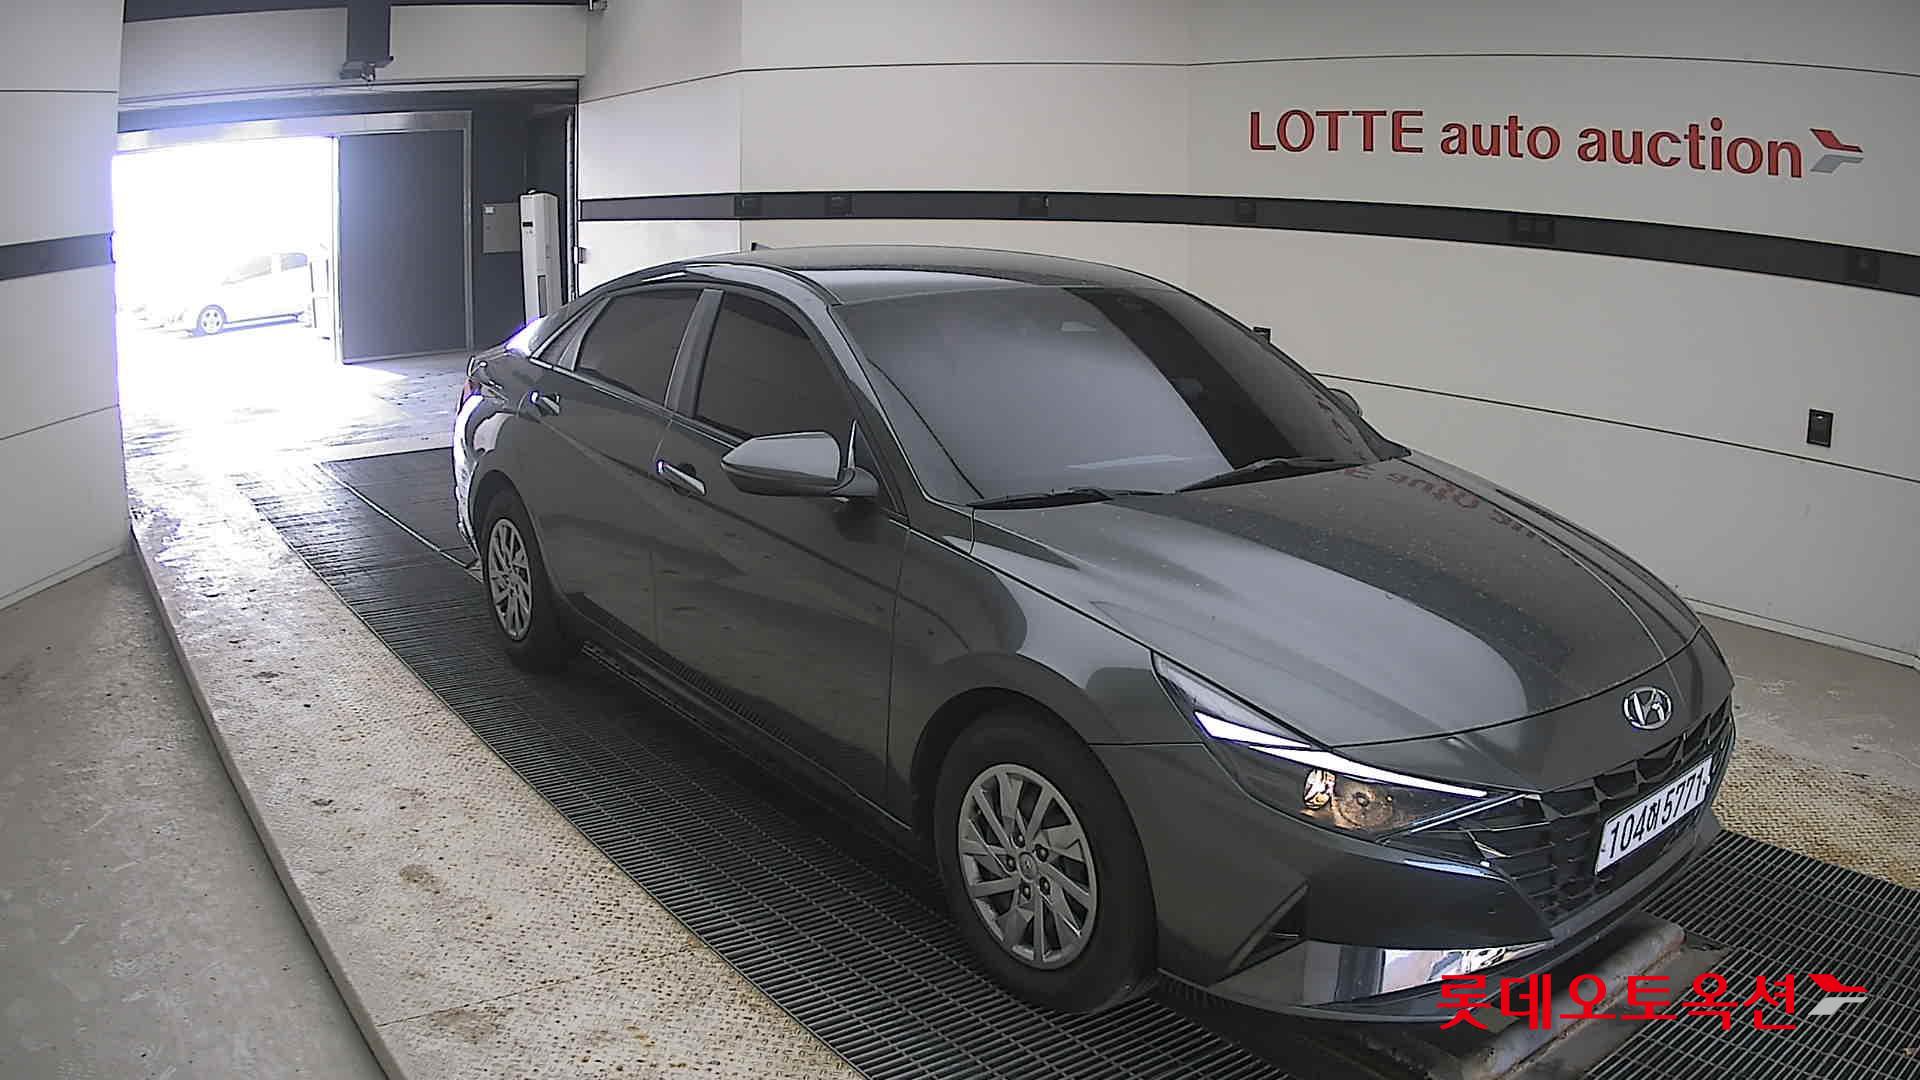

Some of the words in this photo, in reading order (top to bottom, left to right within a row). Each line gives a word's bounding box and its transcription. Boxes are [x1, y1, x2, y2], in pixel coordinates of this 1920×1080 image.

[1248, 109, 1424, 154] LOTTE
[1440, 114, 1562, 160] auto
[1576, 116, 1803, 178] auction
[1661, 767, 1704, 825] 5771
